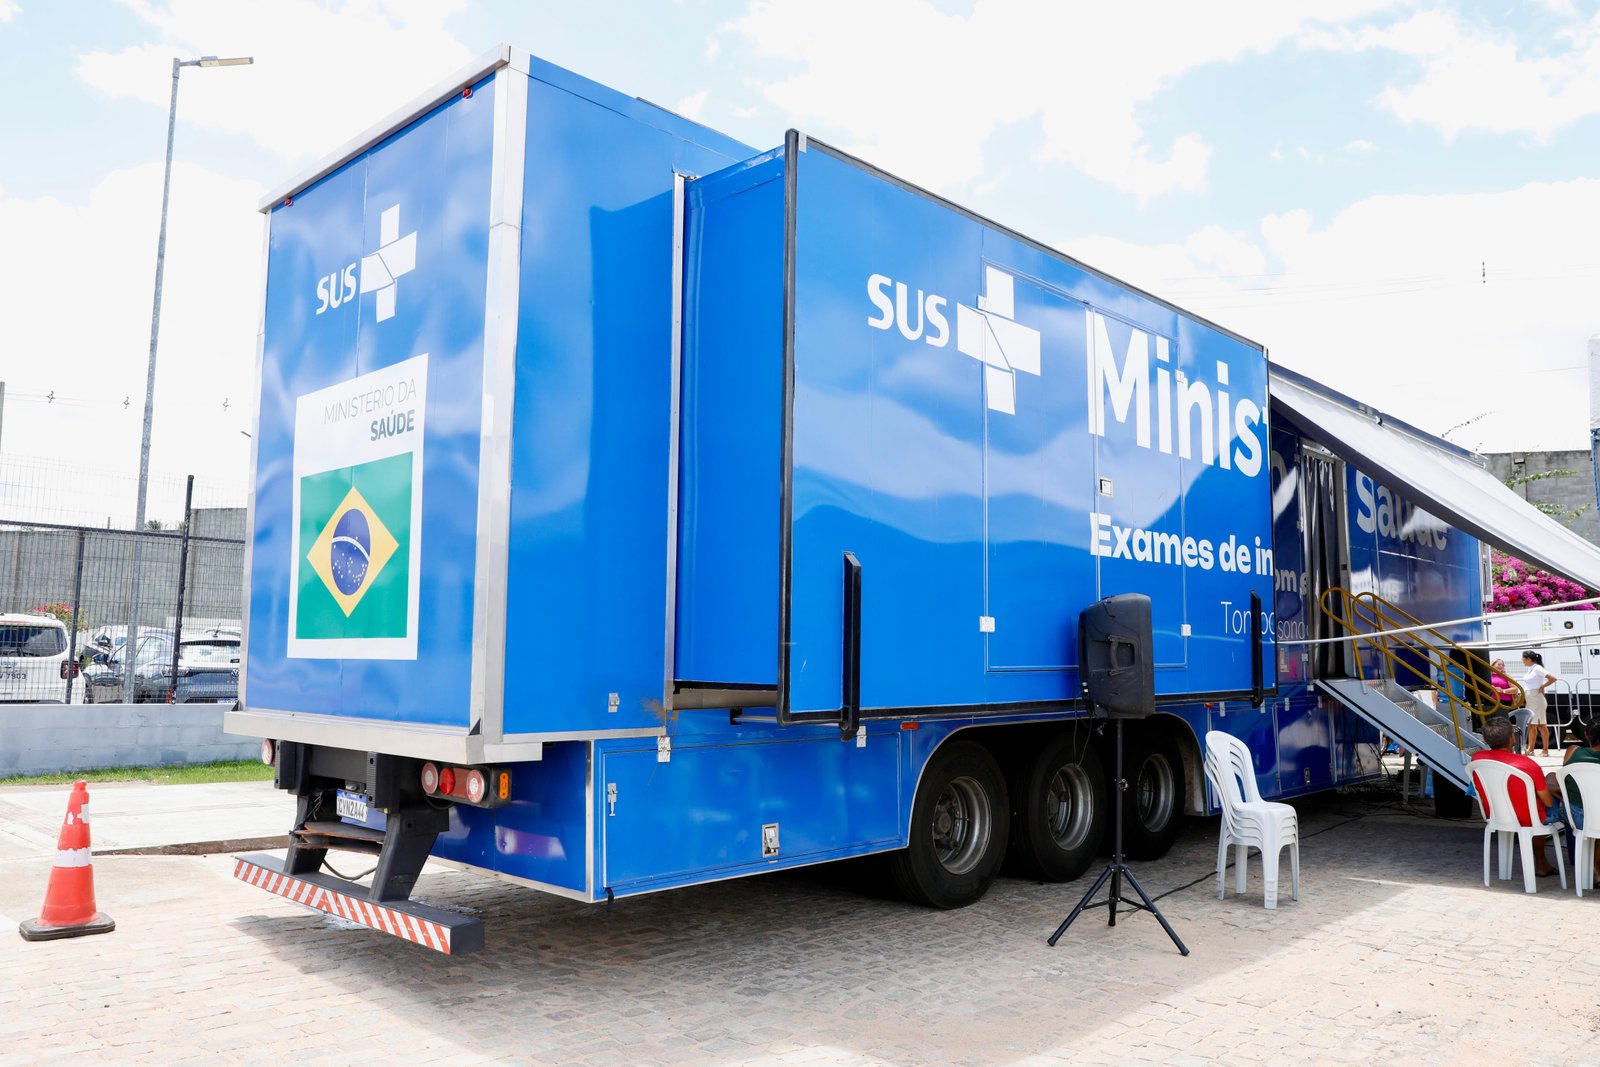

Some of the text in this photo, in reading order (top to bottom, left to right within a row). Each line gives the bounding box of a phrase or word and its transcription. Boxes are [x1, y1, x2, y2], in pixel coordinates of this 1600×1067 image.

[316, 263, 357, 315] SUS
[867, 273, 950, 348] SUS
[323, 377, 417, 425] MINISTÉRIO DA
[370, 409, 415, 441] SAÚDE
[1089, 512, 1214, 570] Exames
[1219, 535, 1251, 572] de
